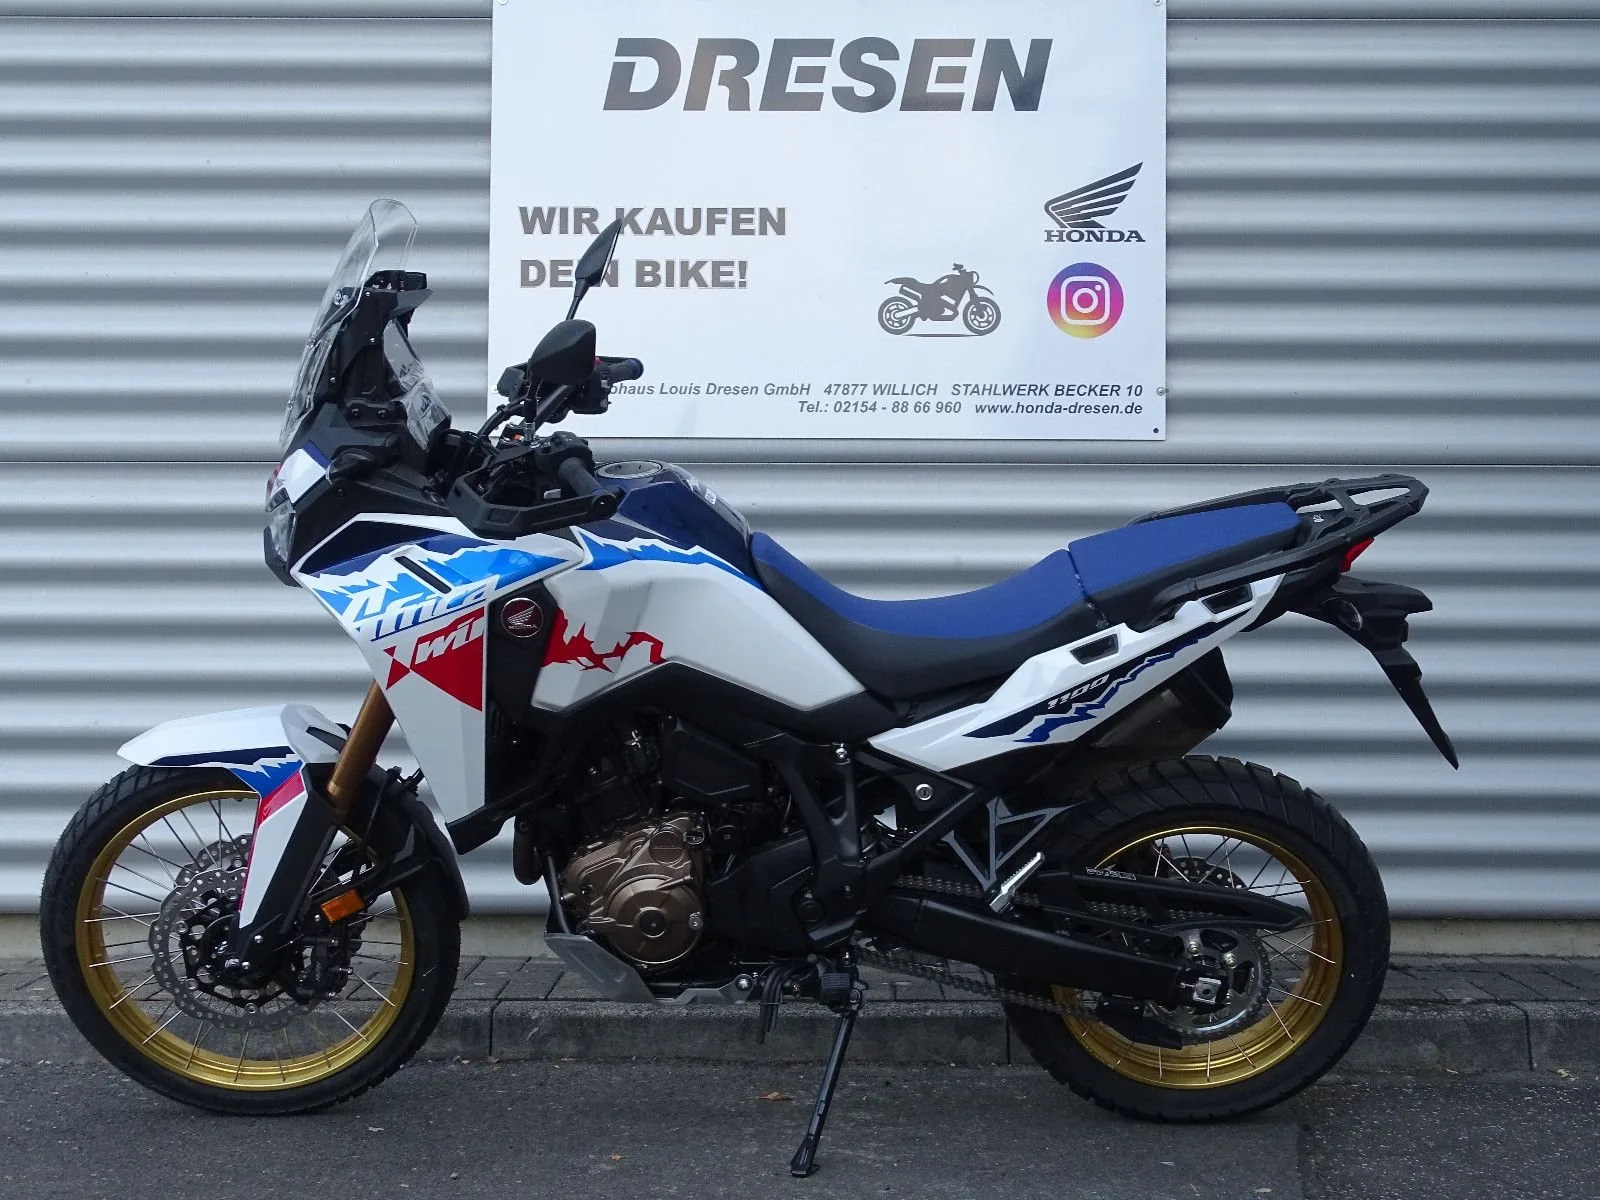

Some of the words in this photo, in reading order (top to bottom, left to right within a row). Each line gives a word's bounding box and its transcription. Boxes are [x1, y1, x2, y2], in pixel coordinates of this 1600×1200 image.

[602, 36, 1053, 113] DRESEN
[518, 206, 600, 235] WIR
[615, 207, 786, 236] KAUFEN
[1044, 229, 1146, 243] HONDA
[520, 259, 619, 288] DEN
[635, 260, 748, 288] BIKE!
[659, 382, 702, 396] Louis
[705, 382, 759, 396] Dresen
[763, 382, 812, 396] GmbH
[823, 383, 868, 396] 47877
[872, 383, 939, 397] WILLICH
[950, 383, 1051, 397] STAHLWERK
[1053, 384, 1122, 397] BECKER
[1126, 384, 1144, 397] 10
[798, 400, 829, 414] Tel.:
[833, 400, 878, 414] 02154
[891, 400, 909, 414] 88
[913, 400, 932, 414] 66
[935, 400, 962, 414] 960
[974, 401, 1143, 415] www.honda-dresen.de
[1046, 673, 1111, 710] 1100
